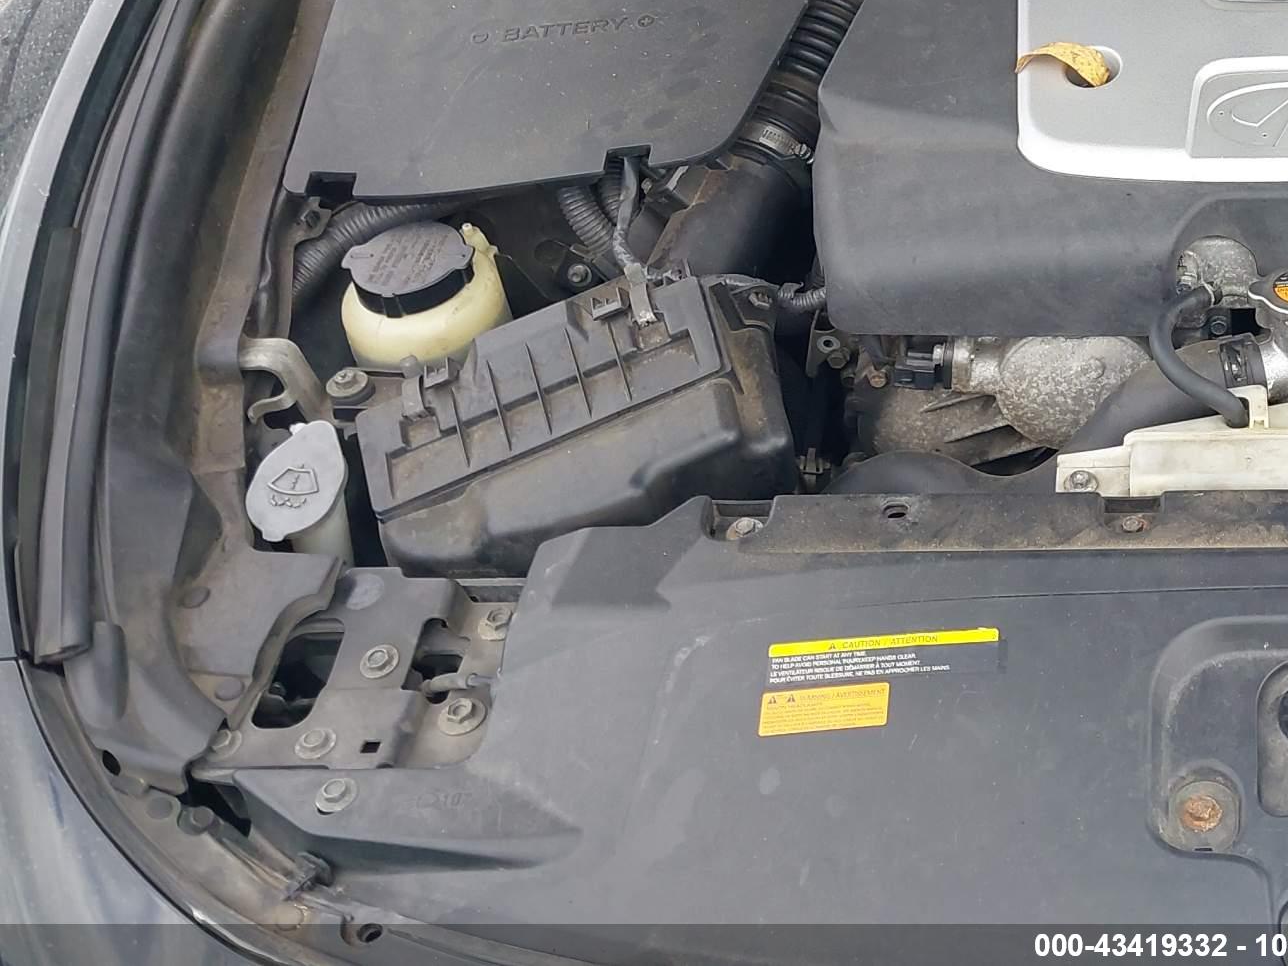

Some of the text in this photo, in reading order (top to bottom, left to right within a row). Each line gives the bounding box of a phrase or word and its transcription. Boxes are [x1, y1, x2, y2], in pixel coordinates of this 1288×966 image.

[503, 16, 628, 43] BATTERY
[842, 639, 880, 649] CAUTION
[890, 635, 938, 645] ATTENTION
